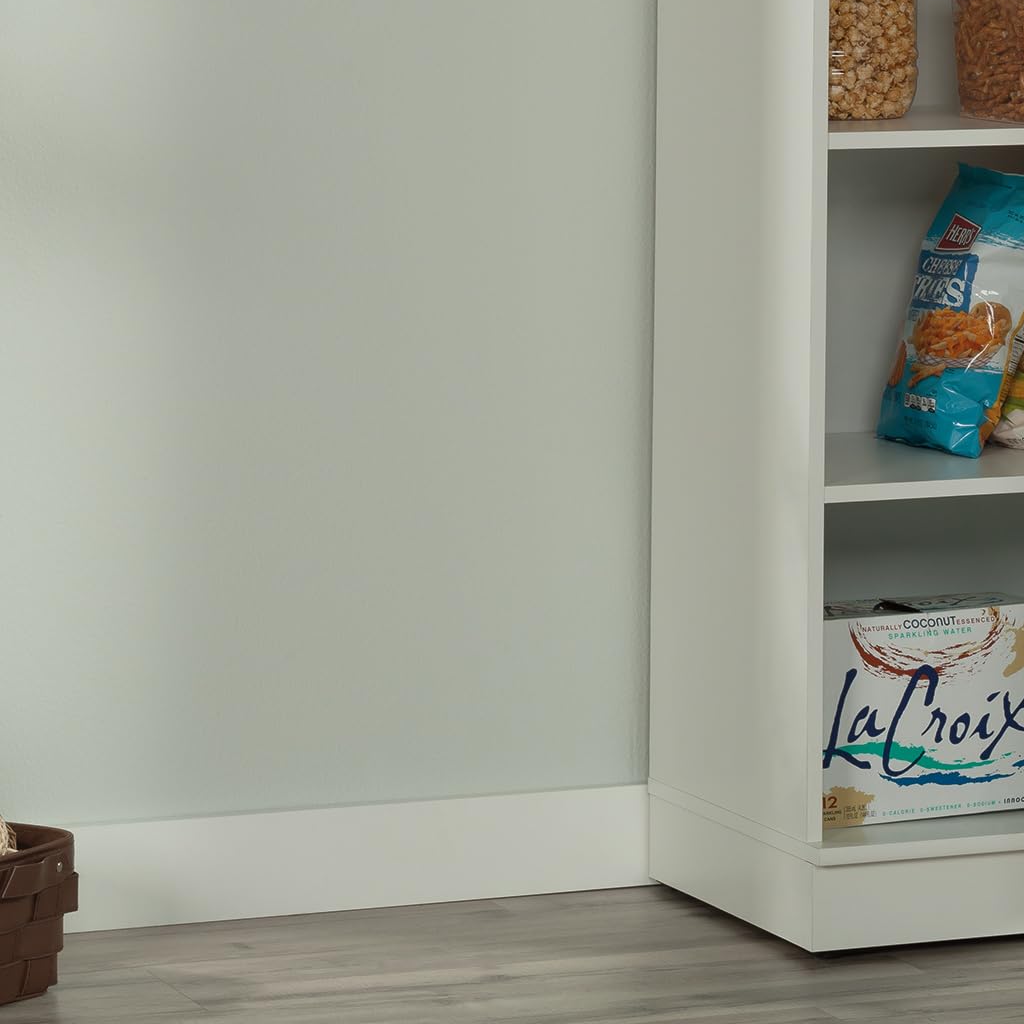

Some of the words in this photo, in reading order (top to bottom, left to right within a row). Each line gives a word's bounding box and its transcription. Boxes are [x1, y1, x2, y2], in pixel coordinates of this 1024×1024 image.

[945, 223, 976, 246] HERR'S
[862, 623, 902, 633] NATURALLY
[903, 616, 956, 630] COCONUT
[956, 617, 995, 626] ESSENCED
[888, 629, 939, 640] SPARKLING
[943, 626, 972, 636] WATER
[822, 796, 838, 809] 12
